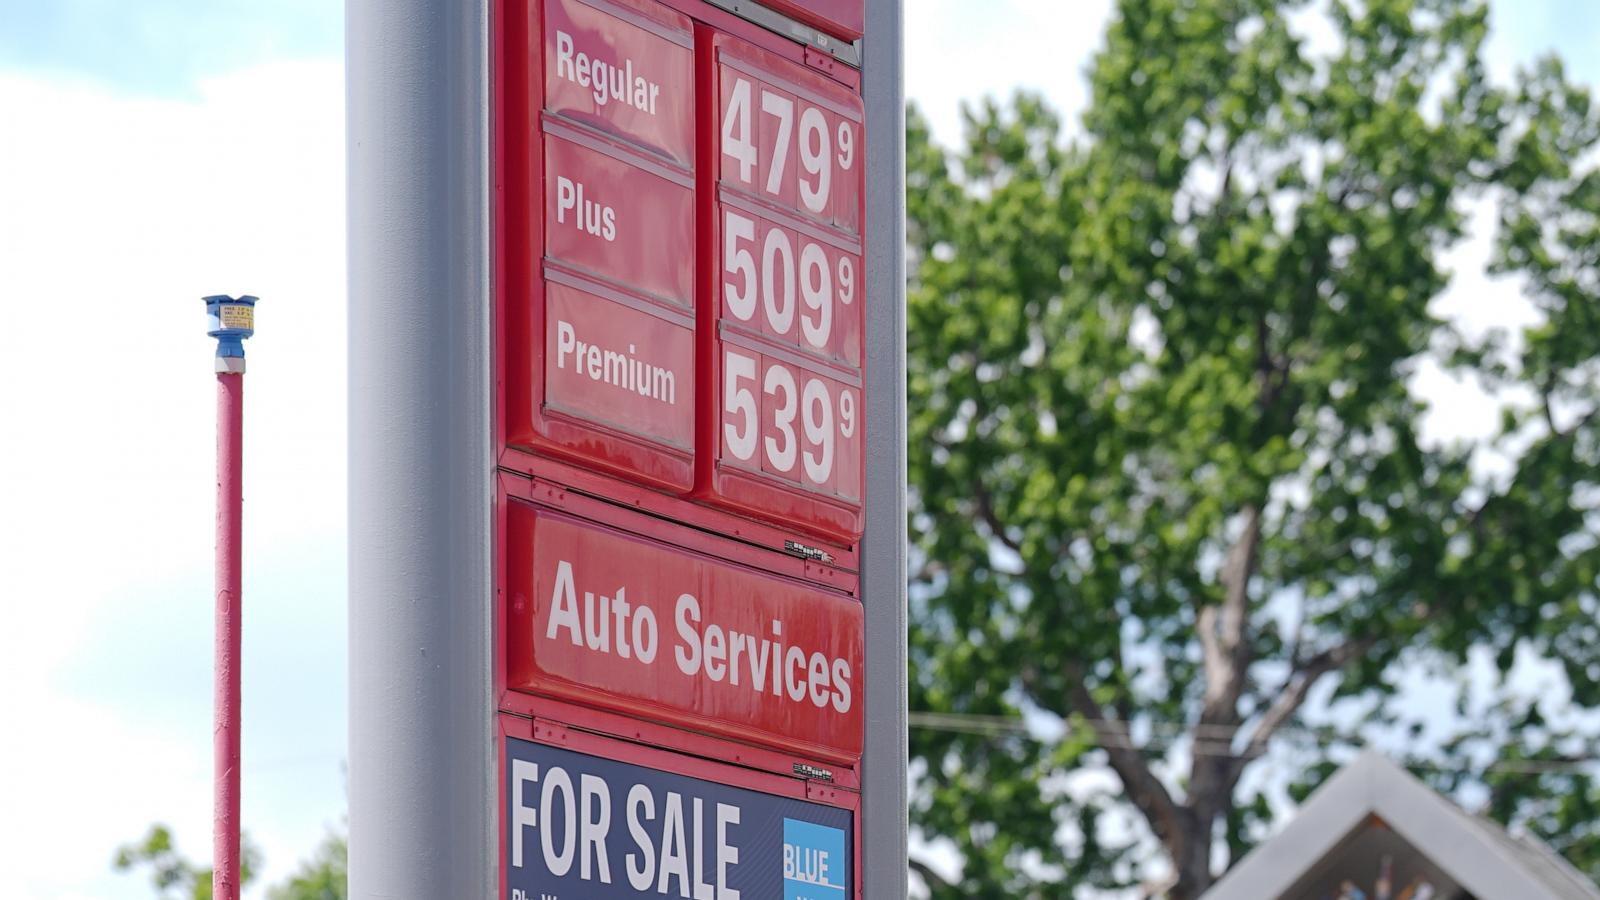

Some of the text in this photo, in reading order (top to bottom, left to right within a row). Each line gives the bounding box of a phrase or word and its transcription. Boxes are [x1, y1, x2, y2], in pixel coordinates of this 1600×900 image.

[556, 30, 660, 116] Regular
[556, 175, 616, 242] Plus
[556, 320, 675, 405] Premium
[546, 560, 852, 714] Auto Services
[512, 758, 741, 900] FOR SALE
[784, 843, 829, 885] BLUE
